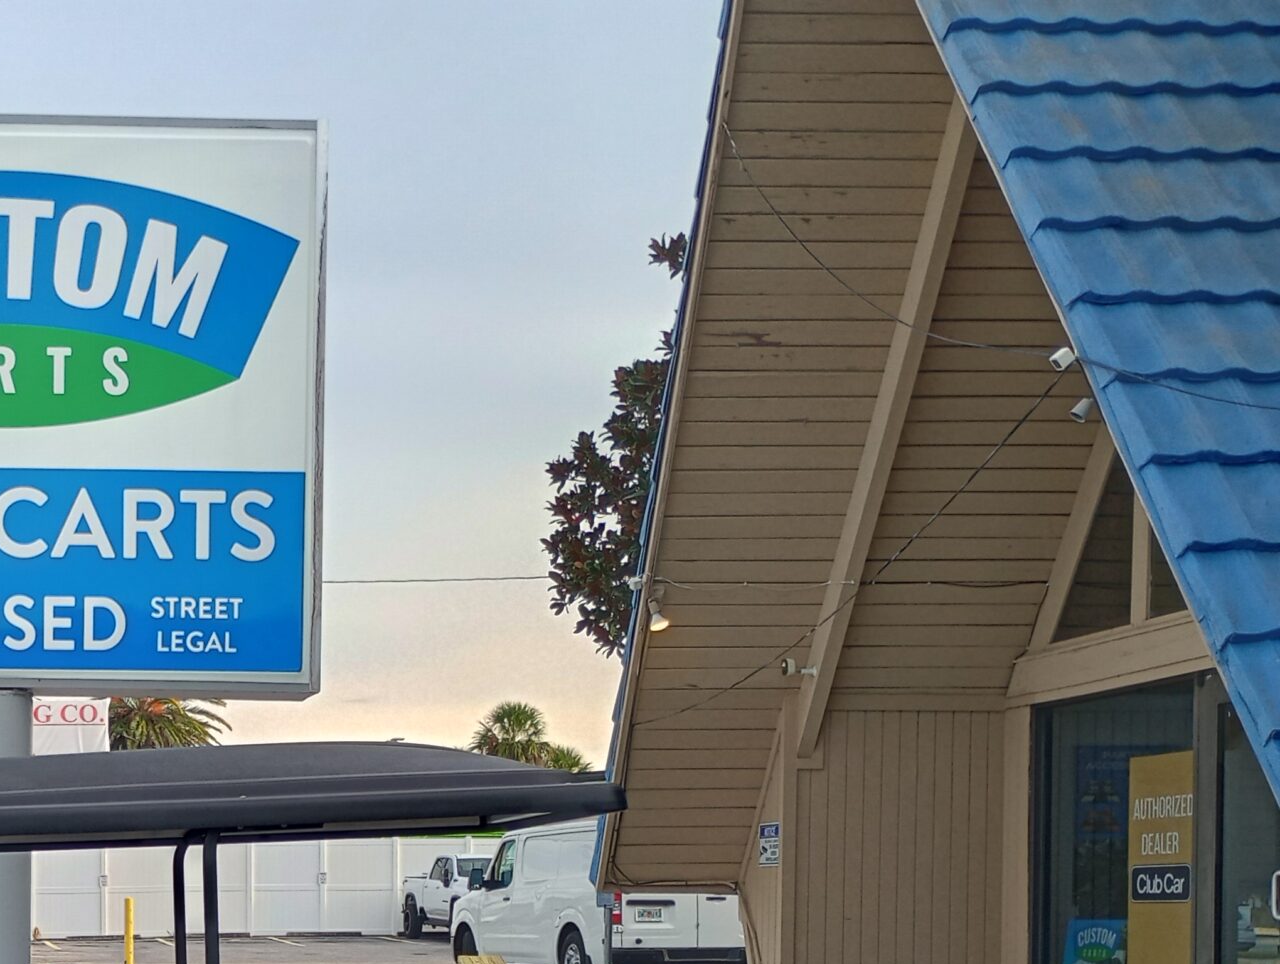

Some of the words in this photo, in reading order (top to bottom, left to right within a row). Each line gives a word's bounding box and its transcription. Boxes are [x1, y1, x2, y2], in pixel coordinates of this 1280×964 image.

[150, 596, 243, 620] STREET
[156, 630, 237, 653] LEGAL
[60, 704, 104, 723] CO.
[1133, 794, 1193, 820] AUTHORIZED
[1141, 832, 1179, 855] DEALER
[1136, 873, 1163, 894] Club
[1163, 873, 1185, 894] Car
[1077, 927, 1117, 949] CUSTOM
